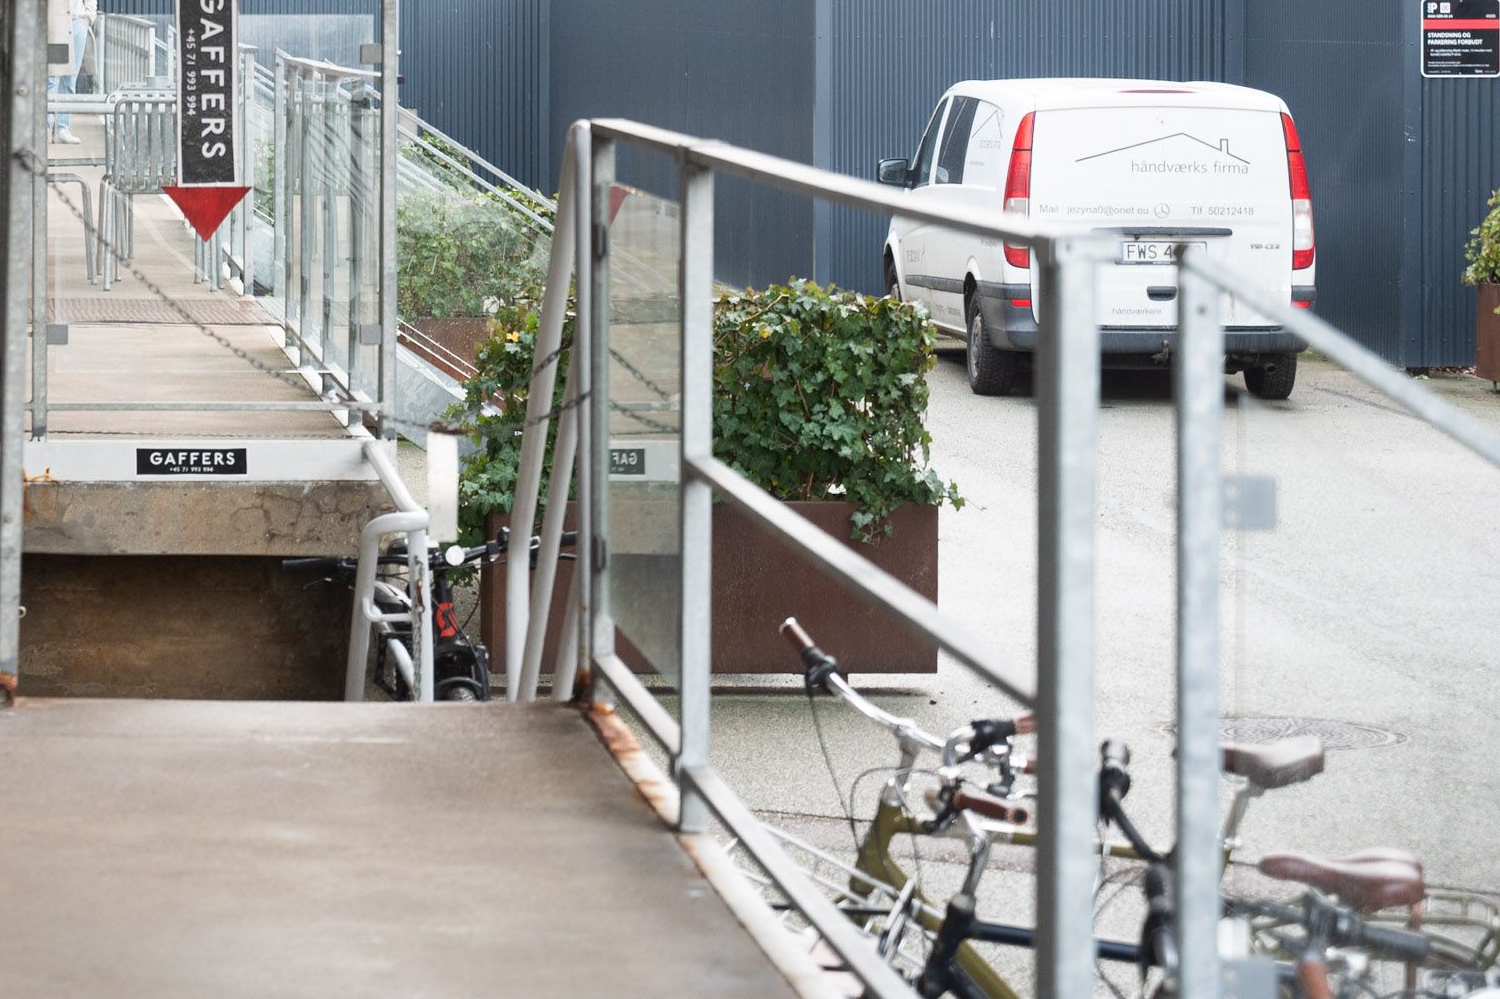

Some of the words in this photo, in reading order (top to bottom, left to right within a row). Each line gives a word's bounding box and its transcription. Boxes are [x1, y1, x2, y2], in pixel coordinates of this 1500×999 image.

[186, 28, 197, 50] +45
[187, 53, 197, 66] 71
[186, 70, 197, 92] 993
[186, 95, 197, 117] 994
[1131, 160, 1208, 173] håndværks
[1214, 160, 1249, 174] firma
[1208, 206, 1254, 216] 50212418
[1126, 243, 1157, 259] FWS
[149, 452, 236, 465] GAFFERS
